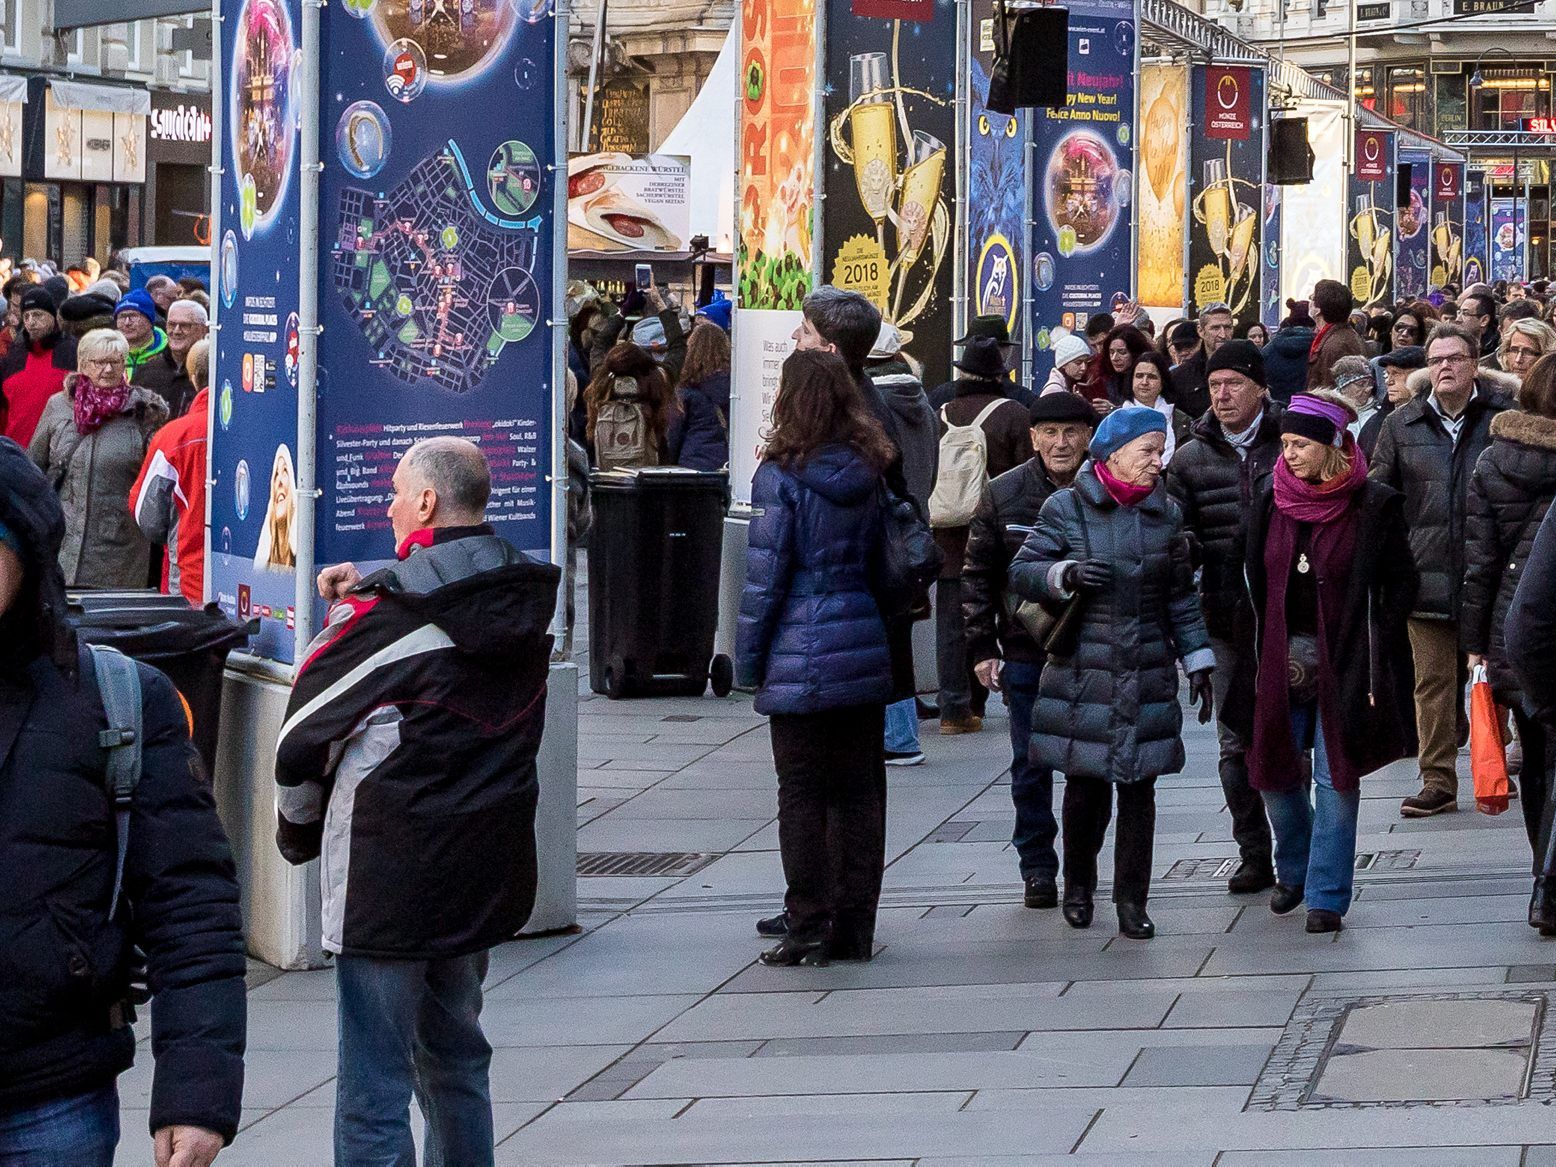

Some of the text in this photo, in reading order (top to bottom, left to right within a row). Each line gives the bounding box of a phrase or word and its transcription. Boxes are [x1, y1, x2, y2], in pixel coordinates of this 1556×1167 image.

[1462, 1, 1471, 12] E.
[1473, 0, 1505, 12] BRAUN
[1078, 92, 1096, 105] New
[1097, 93, 1117, 105] Year!
[1046, 108, 1121, 122] Feice Anno Nuovo!
[598, 164, 687, 173] NGEBACKENE WÜRSTEL
[844, 262, 879, 284] 2018
[1200, 279, 1220, 294] 2018
[383, 424, 406, 434] Hitparty
[406, 423, 418, 432] und
[524, 432, 537, 440] R&B
[336, 439, 378, 449] Silvester-Party
[391, 438, 413, 446] danach
[517, 445, 537, 453] Walzer
[336, 454, 348, 462] und
[362, 467, 378, 475] Band
[511, 486, 521, 494] für
[516, 498, 537, 507] Musik-
[336, 508, 356, 518] Abend
[508, 512, 536, 520] Kultbands
[335, 522, 366, 531] feuerwerk
